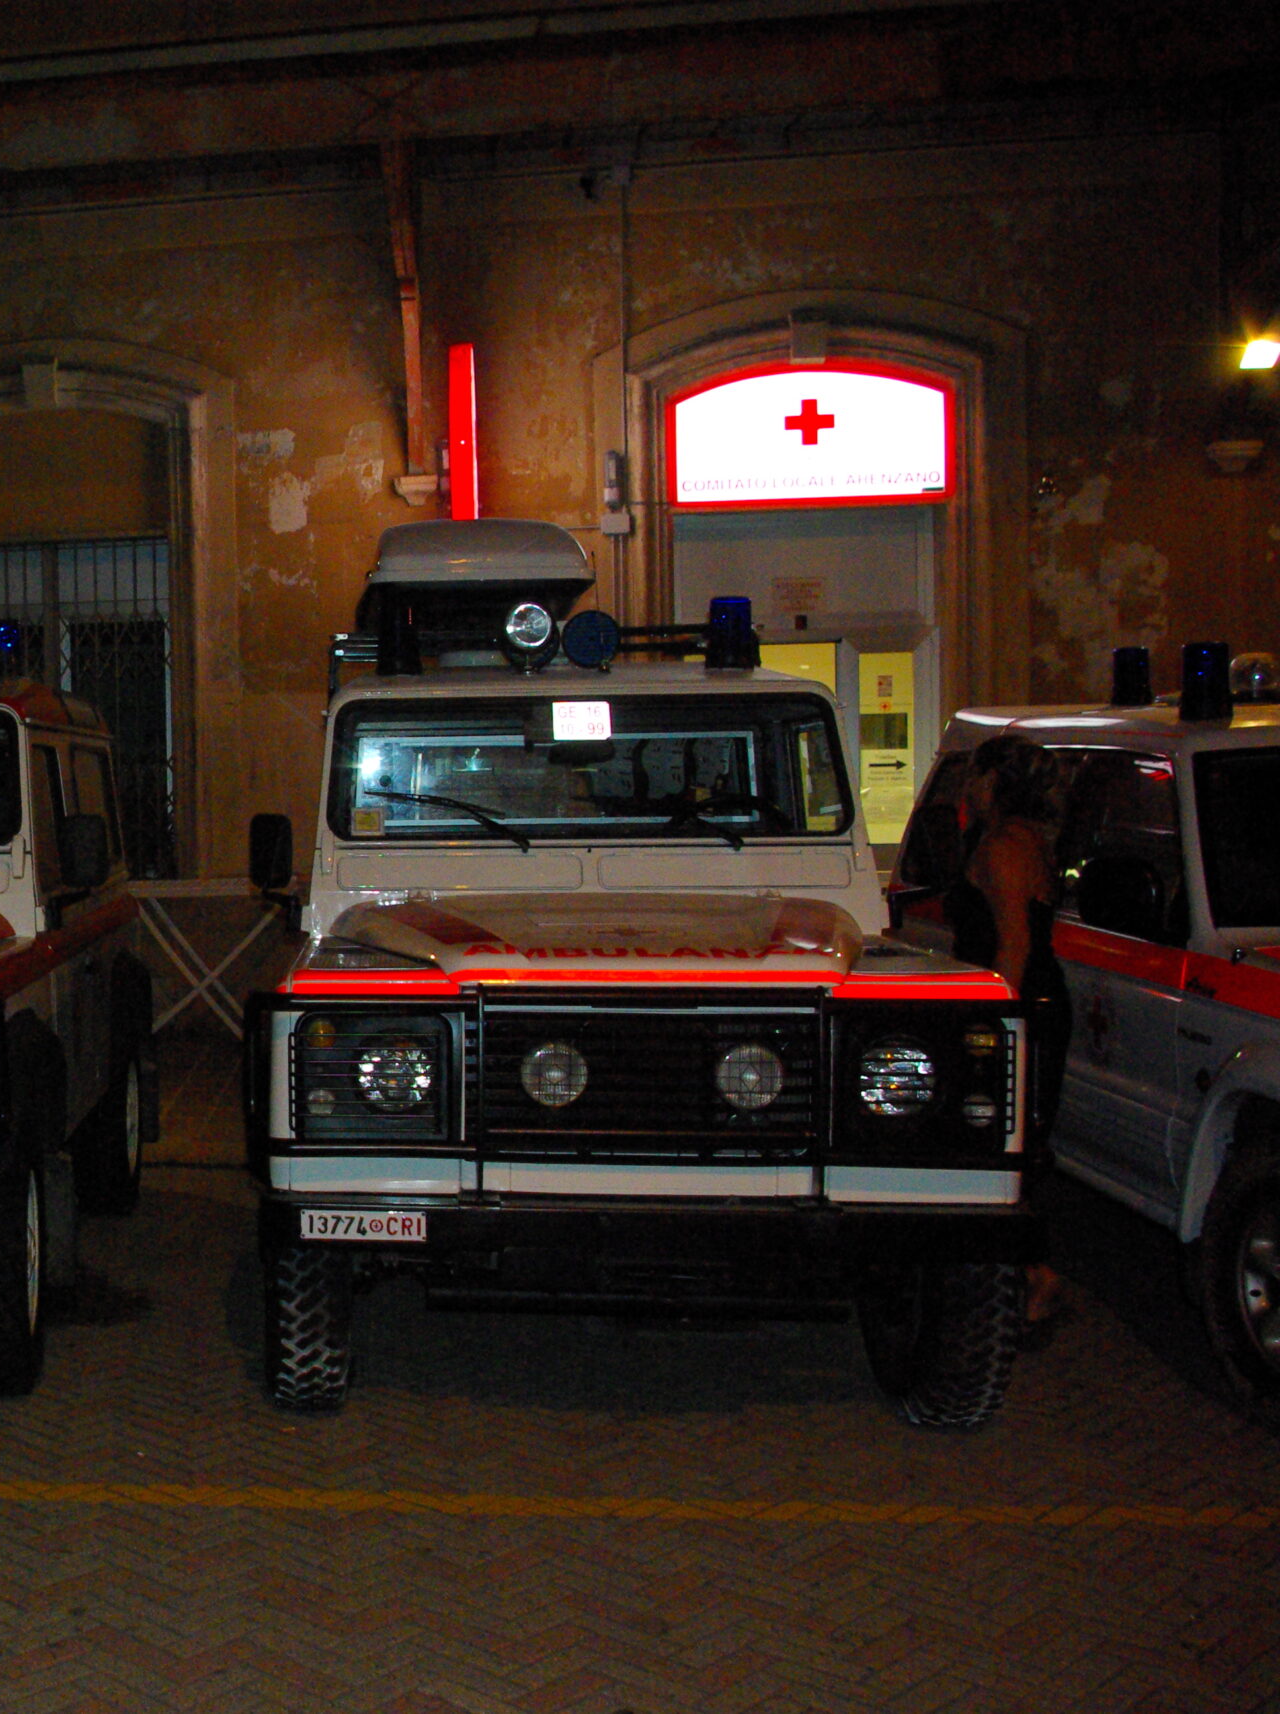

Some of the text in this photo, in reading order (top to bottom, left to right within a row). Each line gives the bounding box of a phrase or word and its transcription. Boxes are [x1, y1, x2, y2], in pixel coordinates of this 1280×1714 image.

[681, 470, 941, 493] COMITATO LOCALE ARENZANO
[557, 705, 577, 719] GE
[464, 942, 834, 960] AMBULANZA
[308, 1213, 422, 1237] 13774 CRI
